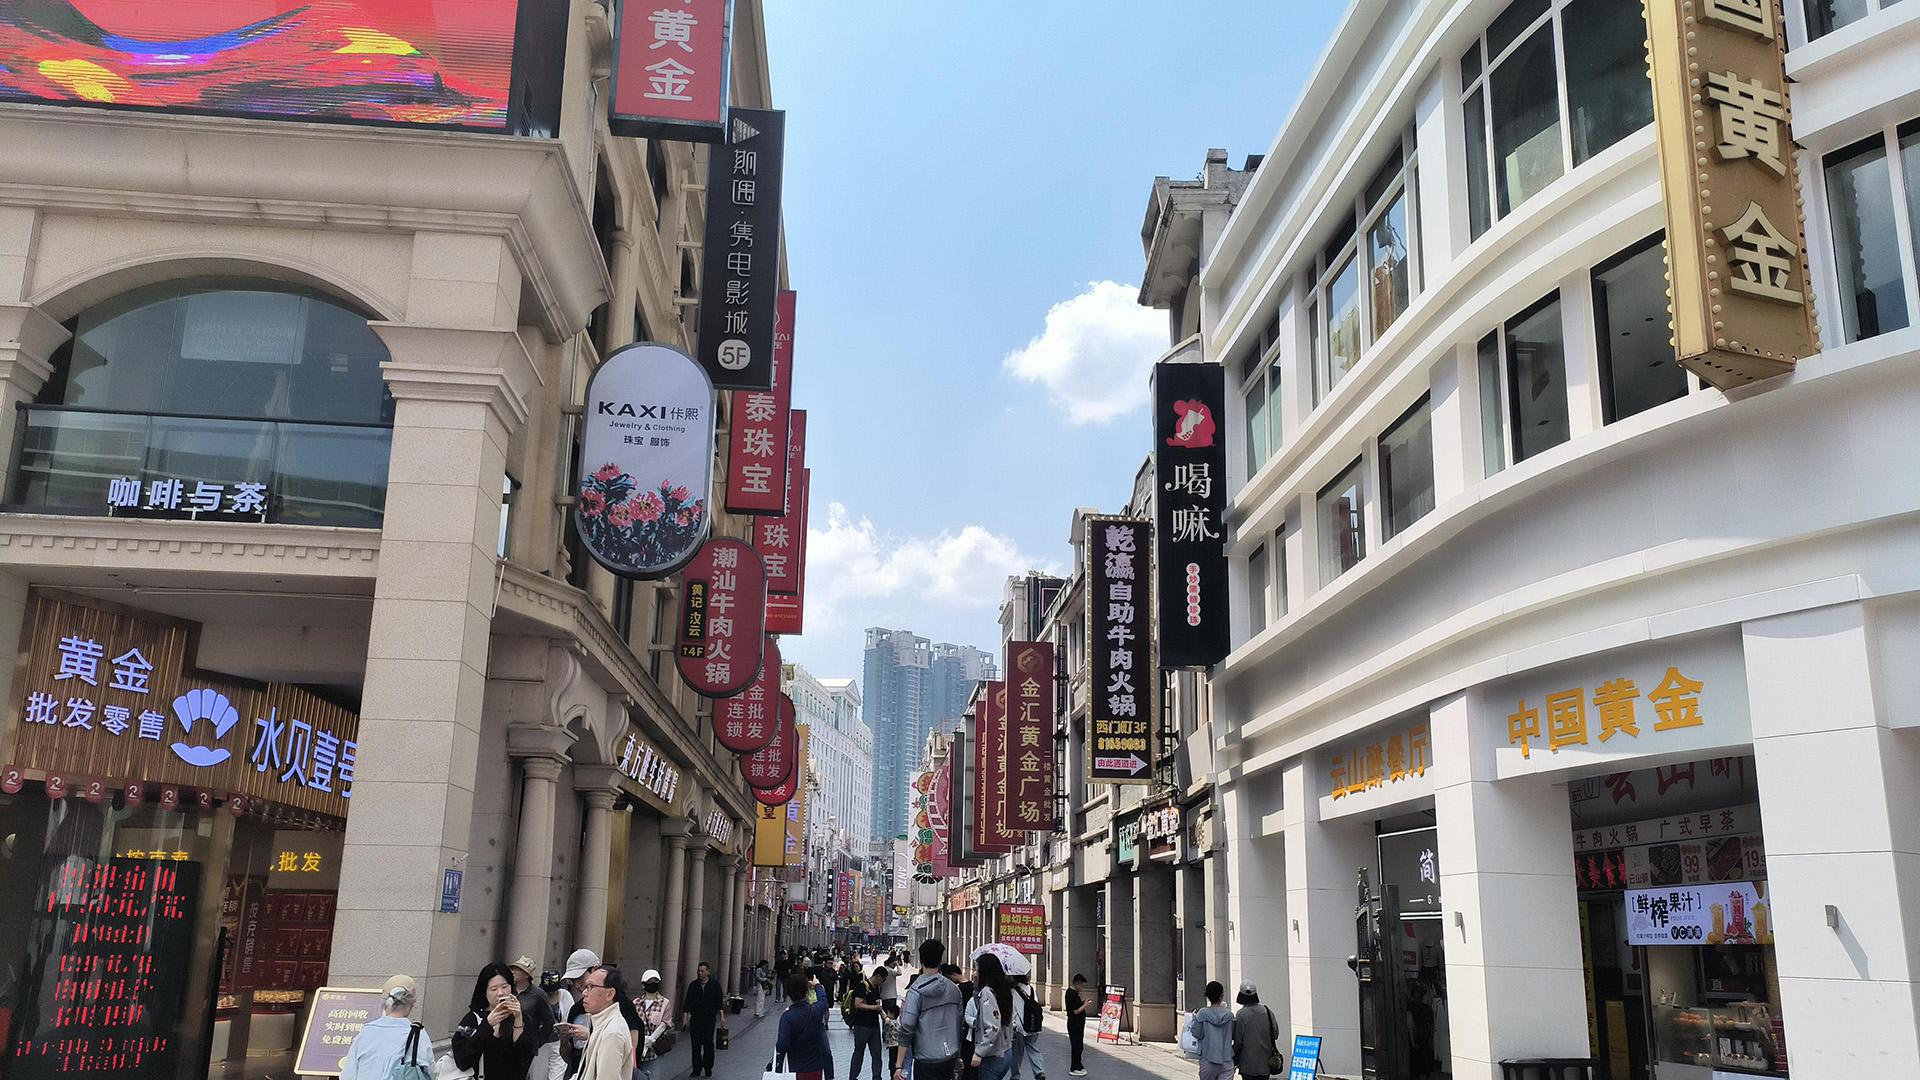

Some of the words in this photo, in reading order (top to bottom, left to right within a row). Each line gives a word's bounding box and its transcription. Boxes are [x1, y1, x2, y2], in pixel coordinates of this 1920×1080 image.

[643, 0, 698, 101] 黄金
[721, 346, 747, 364] 5F
[598, 401, 666, 419] KAXI
[609, 421, 642, 431] Jewelry
[653, 424, 685, 433] Clothing
[624, 435, 644, 445] 珠宝
[650, 437, 670, 447] 服饰
[107, 477, 268, 513] 咖啡与茶
[1165, 462, 1220, 542] 喝嘛
[705, 547, 738, 684] 潮汕牛肉火锅
[54, 635, 154, 694] 黄金
[25, 691, 166, 741] 批发零售
[1508, 667, 1704, 758] 中国黄金
[1018, 676, 1041, 823] 金汇黄金广场
[1329, 724, 1429, 801] 云山醉餐厅
[1576, 826, 1638, 849] 牛肉火锅
[1660, 809, 1735, 839] 广式早茶
[277, 851, 322, 872] 批发
[897, 865, 907, 889] ANTA
[1684, 855, 1700, 875] 99
[328, 1008, 369, 1019] 高价回收
[321, 1034, 357, 1045] 免费测
